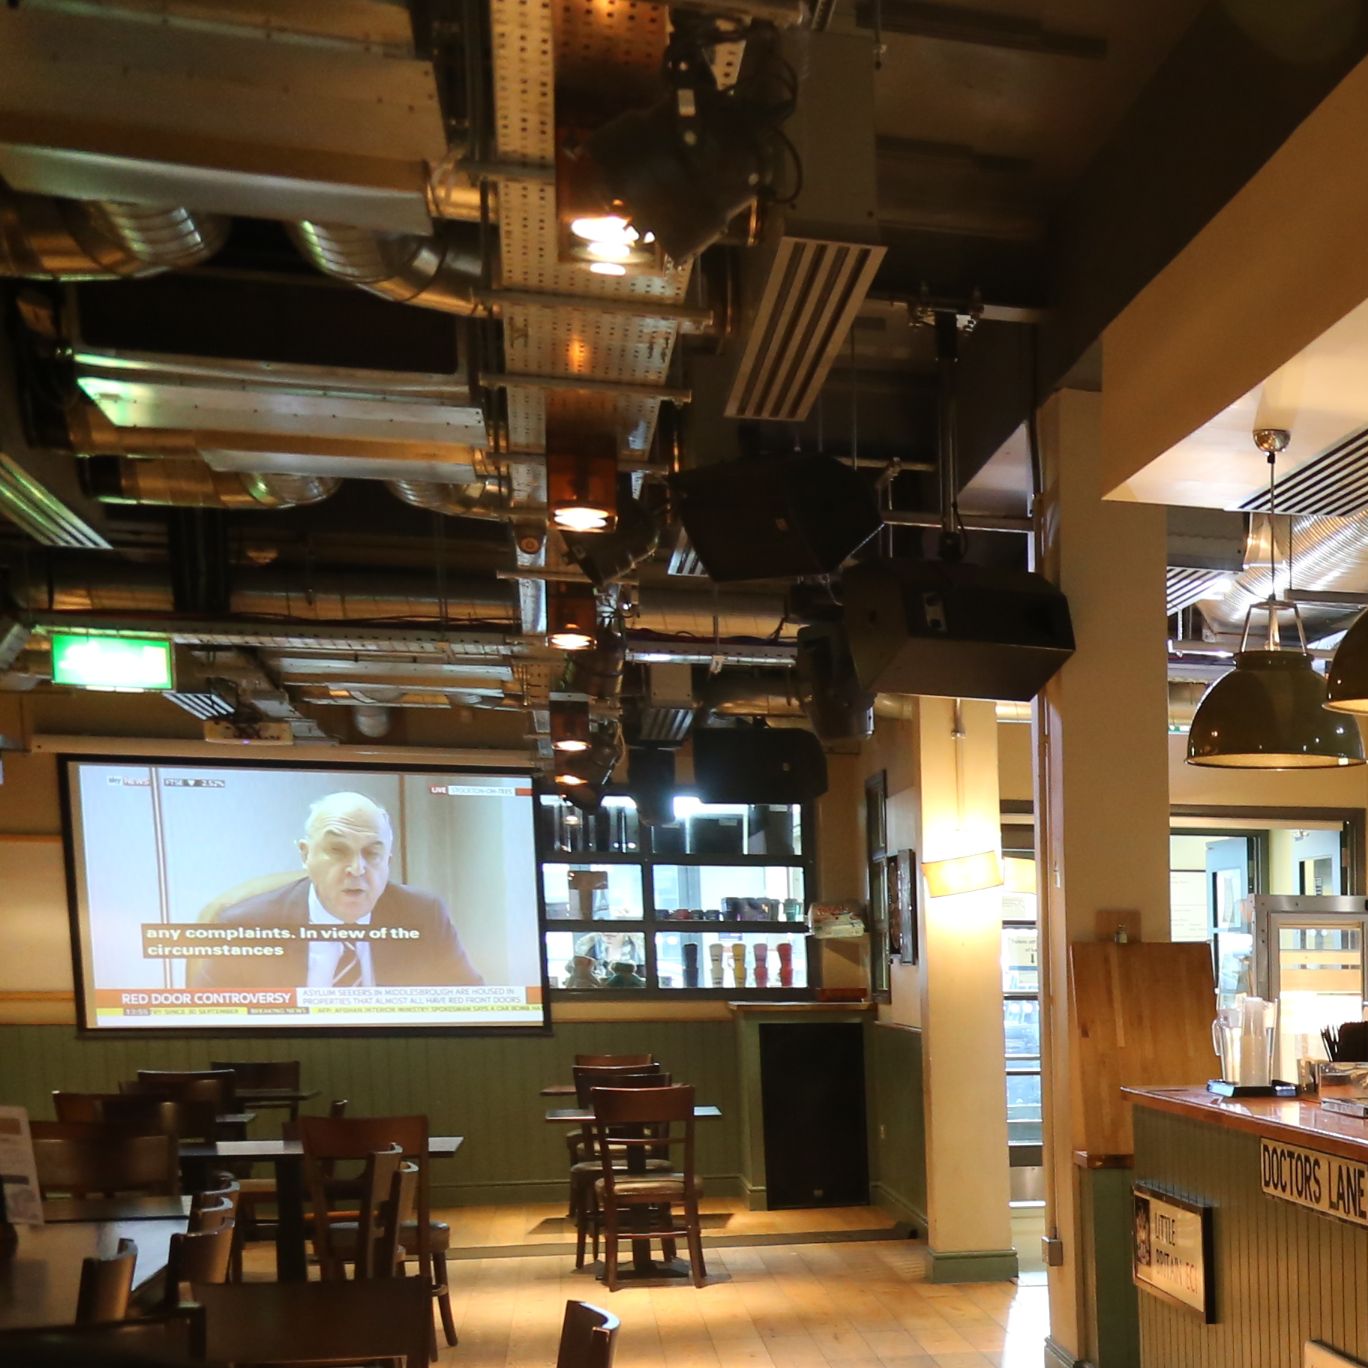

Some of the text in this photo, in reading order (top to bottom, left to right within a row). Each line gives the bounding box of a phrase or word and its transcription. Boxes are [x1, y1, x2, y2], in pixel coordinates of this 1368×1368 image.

[147, 926, 420, 940] any complaints. In view of the
[148, 944, 284, 956] circumstances
[122, 992, 292, 1005] RED DOOR CONTROVERSY
[302, 989, 336, 997] ASYLUM
[385, 988, 454, 996] MIDDLESBROUGH
[302, 997, 351, 1005] PROPERTIES
[353, 997, 373, 1005] THAT
[448, 996, 463, 1004] RED
[465, 996, 491, 1004] FRONT
[1262, 1143, 1367, 1221] DOCTORS LANE
[1154, 1211, 1176, 1247] LITTLE
